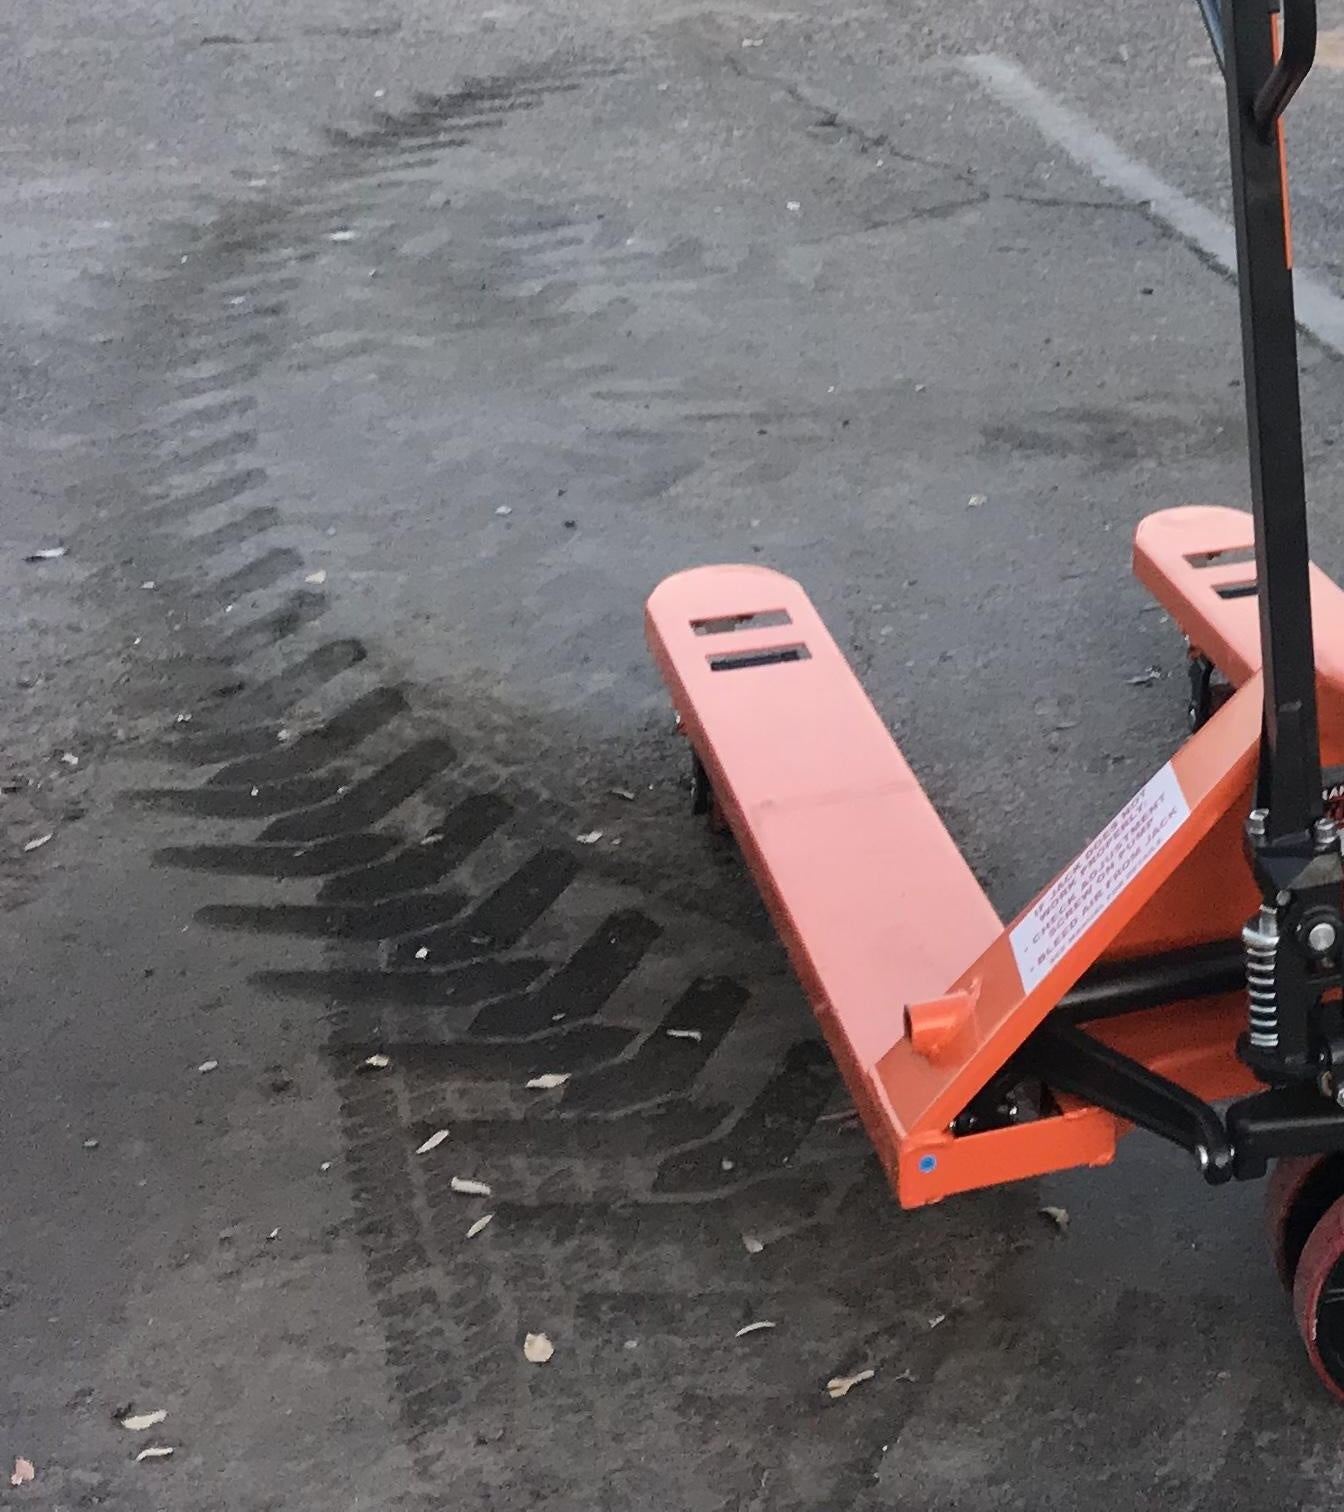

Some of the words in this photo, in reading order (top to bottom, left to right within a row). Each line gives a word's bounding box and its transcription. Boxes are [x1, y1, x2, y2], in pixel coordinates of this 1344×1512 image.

[1032, 892, 1076, 945] CHECK
[1079, 791, 1166, 891] ADJUSTMENT
[1036, 915, 1078, 966] BLEED
[1081, 888, 1102, 916] AIR
[1104, 845, 1141, 890] FROM
[1143, 806, 1176, 847] JACK
[1039, 877, 1076, 922] WORK
[1079, 802, 1144, 877] PROPERLY
[1047, 884, 1093, 939] SCREW
[1095, 859, 1115, 885] ON
[1118, 817, 1154, 860] PUMP
[1049, 861, 1081, 900] JACK
[1084, 820, 1118, 860] DOES
[1120, 788, 1146, 820] NOT
